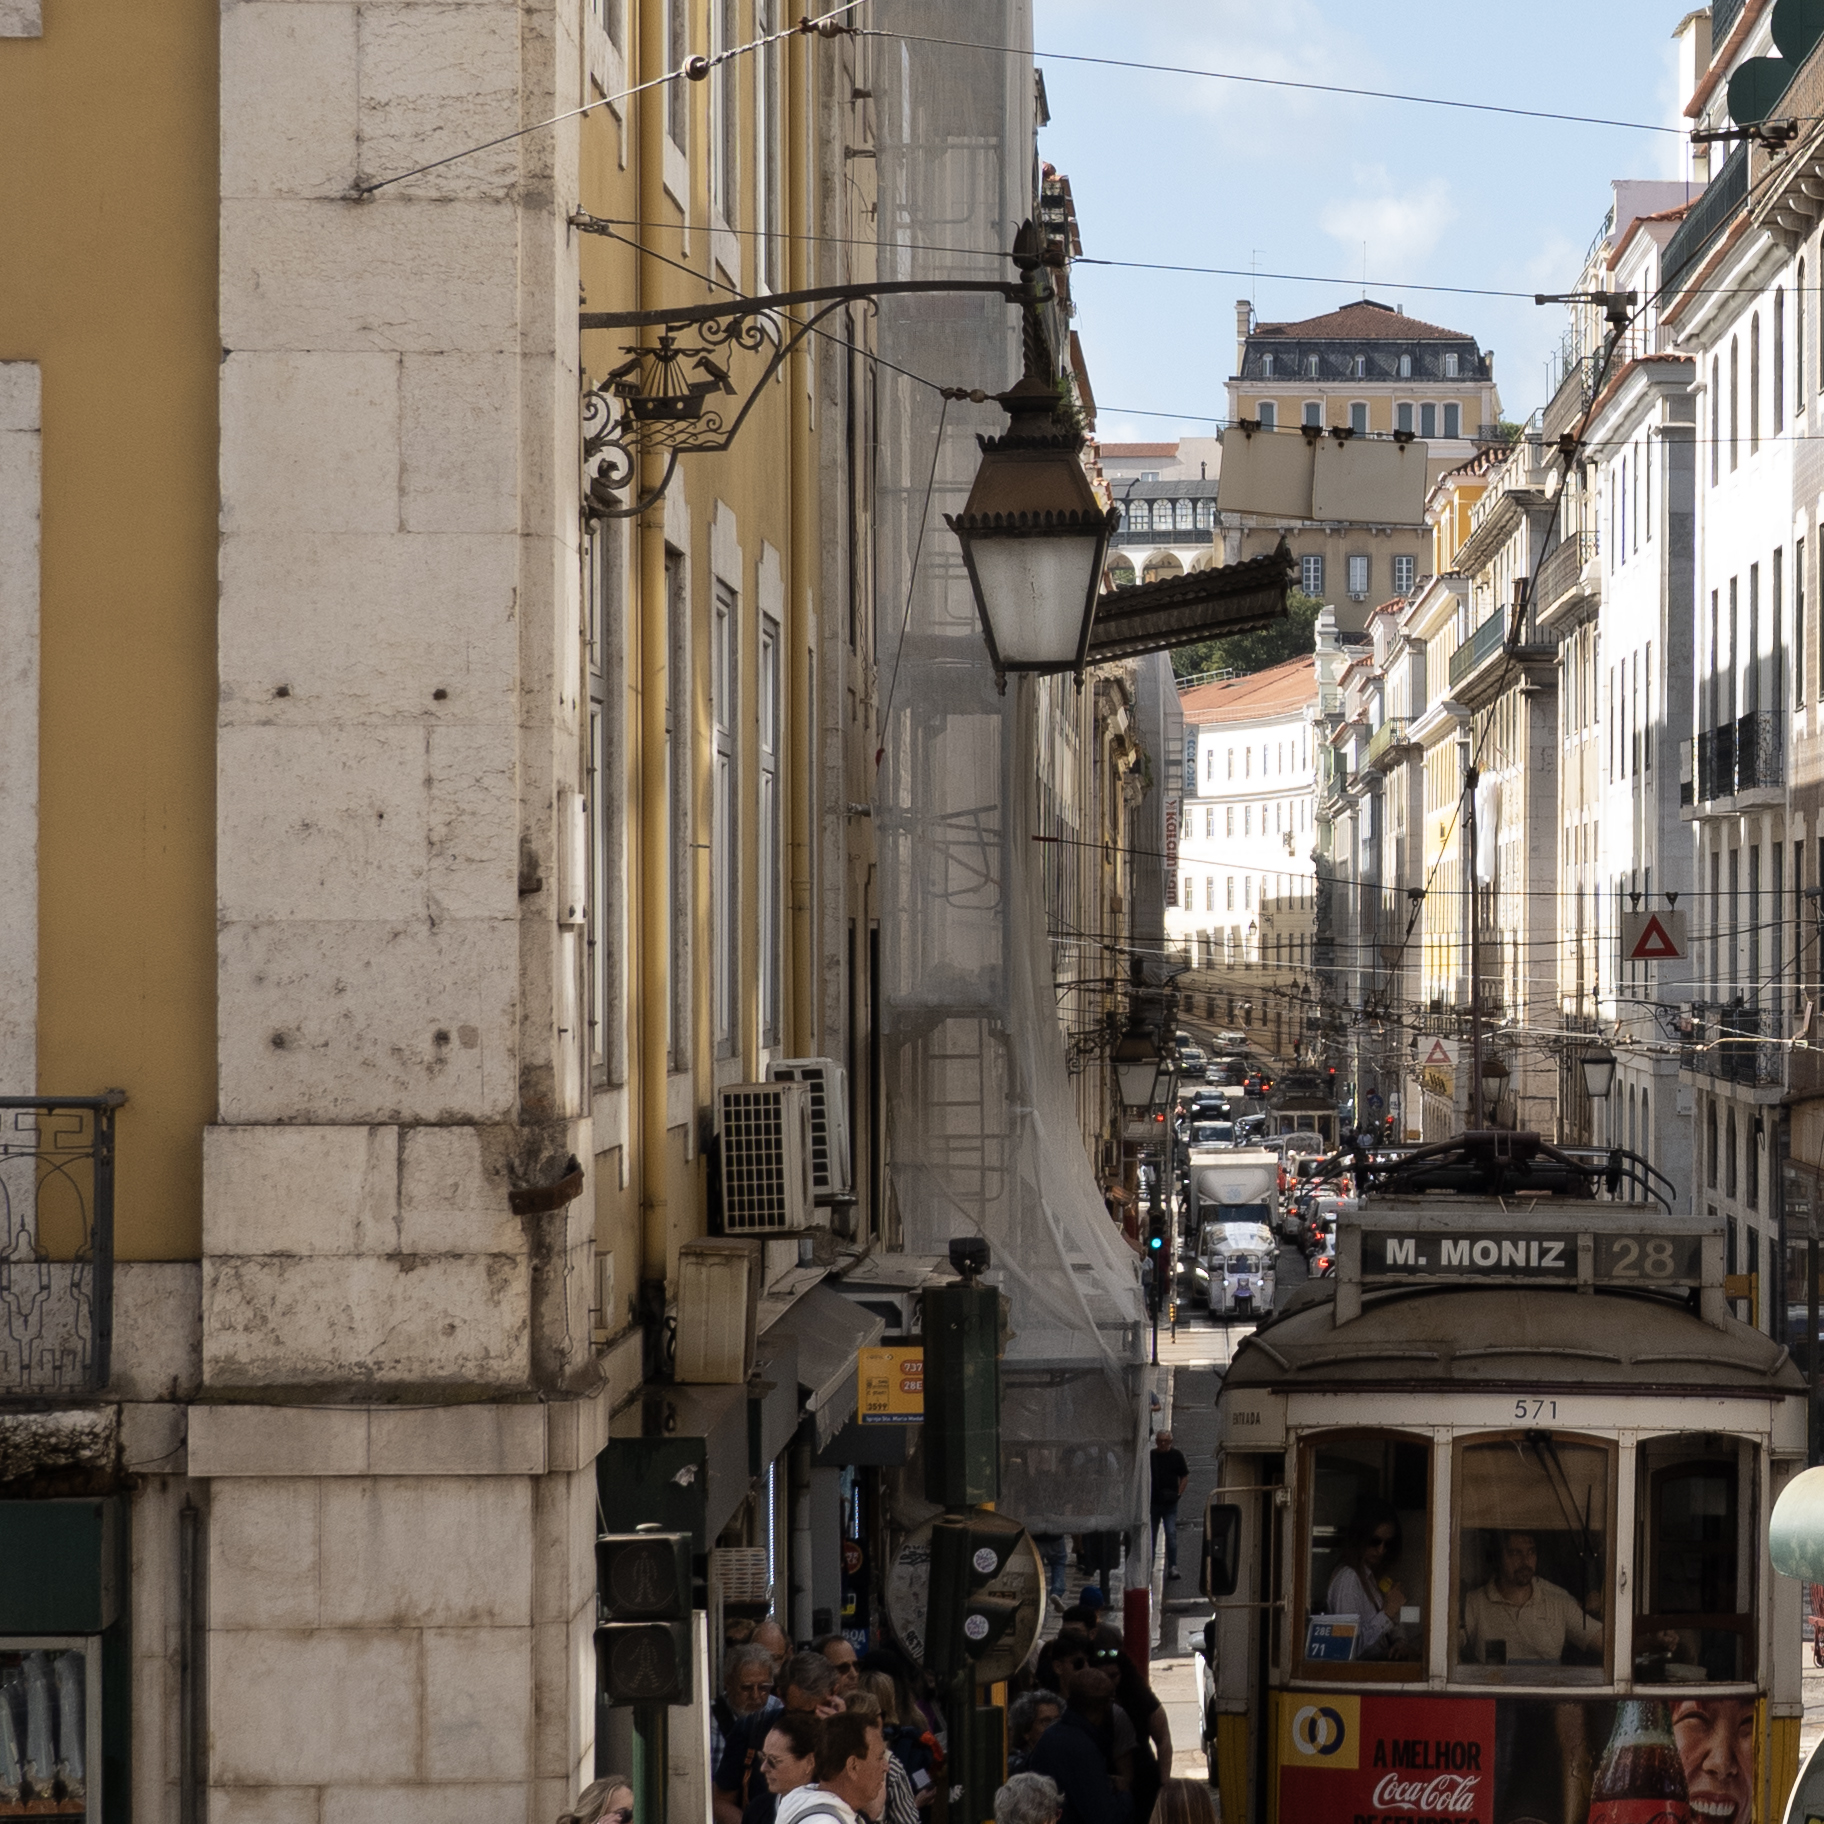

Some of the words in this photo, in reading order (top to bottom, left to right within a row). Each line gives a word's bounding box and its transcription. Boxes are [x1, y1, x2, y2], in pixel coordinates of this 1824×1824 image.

[1386, 1238, 1427, 1266] M.
[1440, 1239, 1566, 1268] MONIZ
[1611, 1237, 1675, 1277] 28
[903, 1362, 923, 1372] 737
[903, 1381, 923, 1390] 28E
[1514, 1399, 1558, 1420] 571
[1231, 1411, 1261, 1426] ENTRADA
[842, 1629, 866, 1643] BOA
[1313, 1626, 1332, 1637] 28E
[1311, 1643, 1326, 1657] 71
[1373, 1738, 1388, 1769] A
[1391, 1739, 1482, 1771] MELHOR
[1372, 1772, 1482, 1812] Coca-Cola
